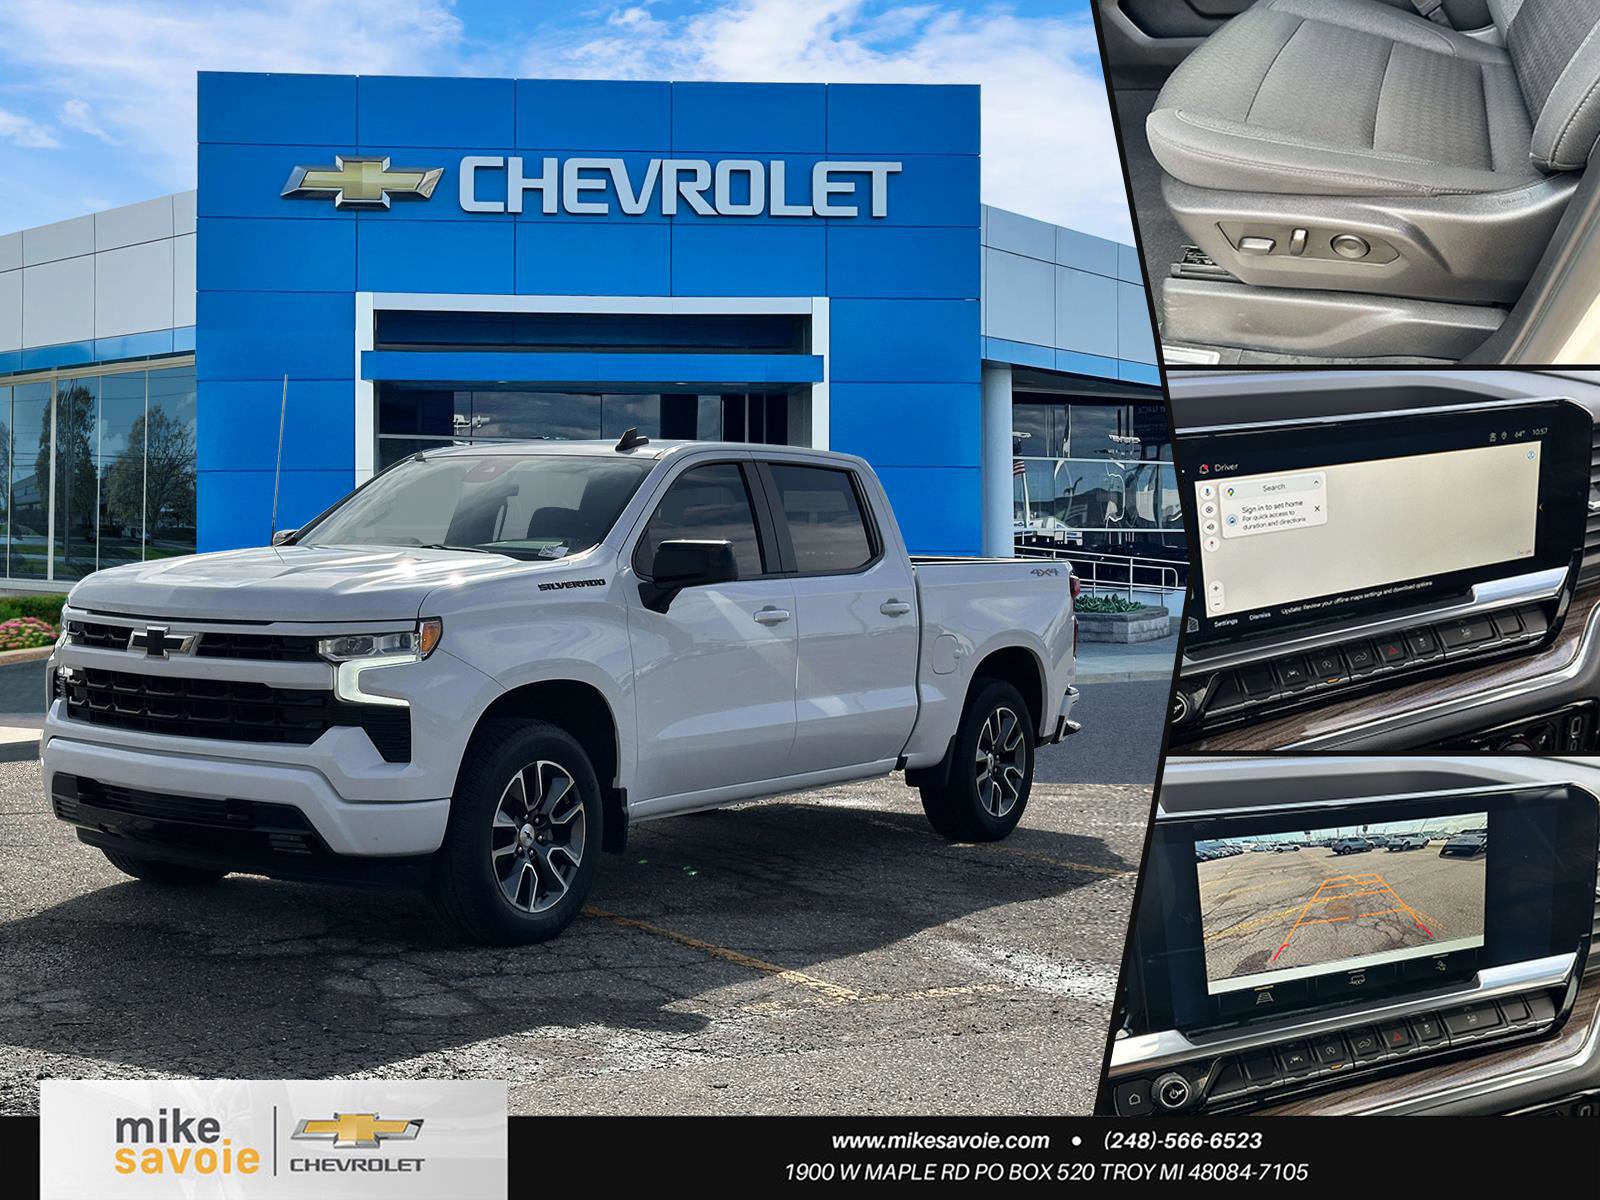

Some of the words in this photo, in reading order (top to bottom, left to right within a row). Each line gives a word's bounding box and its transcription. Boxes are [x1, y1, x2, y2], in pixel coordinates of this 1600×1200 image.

[459, 156, 903, 218] CHEVROLET
[1214, 463, 1239, 472] Driver
[1262, 483, 1286, 492] Search
[1241, 505, 1257, 515] Sign
[1274, 502, 1284, 510] set
[1252, 513, 1268, 521] quick
[1243, 522, 1267, 530] duration
[1279, 517, 1306, 525] directions
[538, 579, 606, 591] SILVERADO
[1249, 612, 1272, 621] Dismiss
[1214, 618, 1239, 628] Settings
